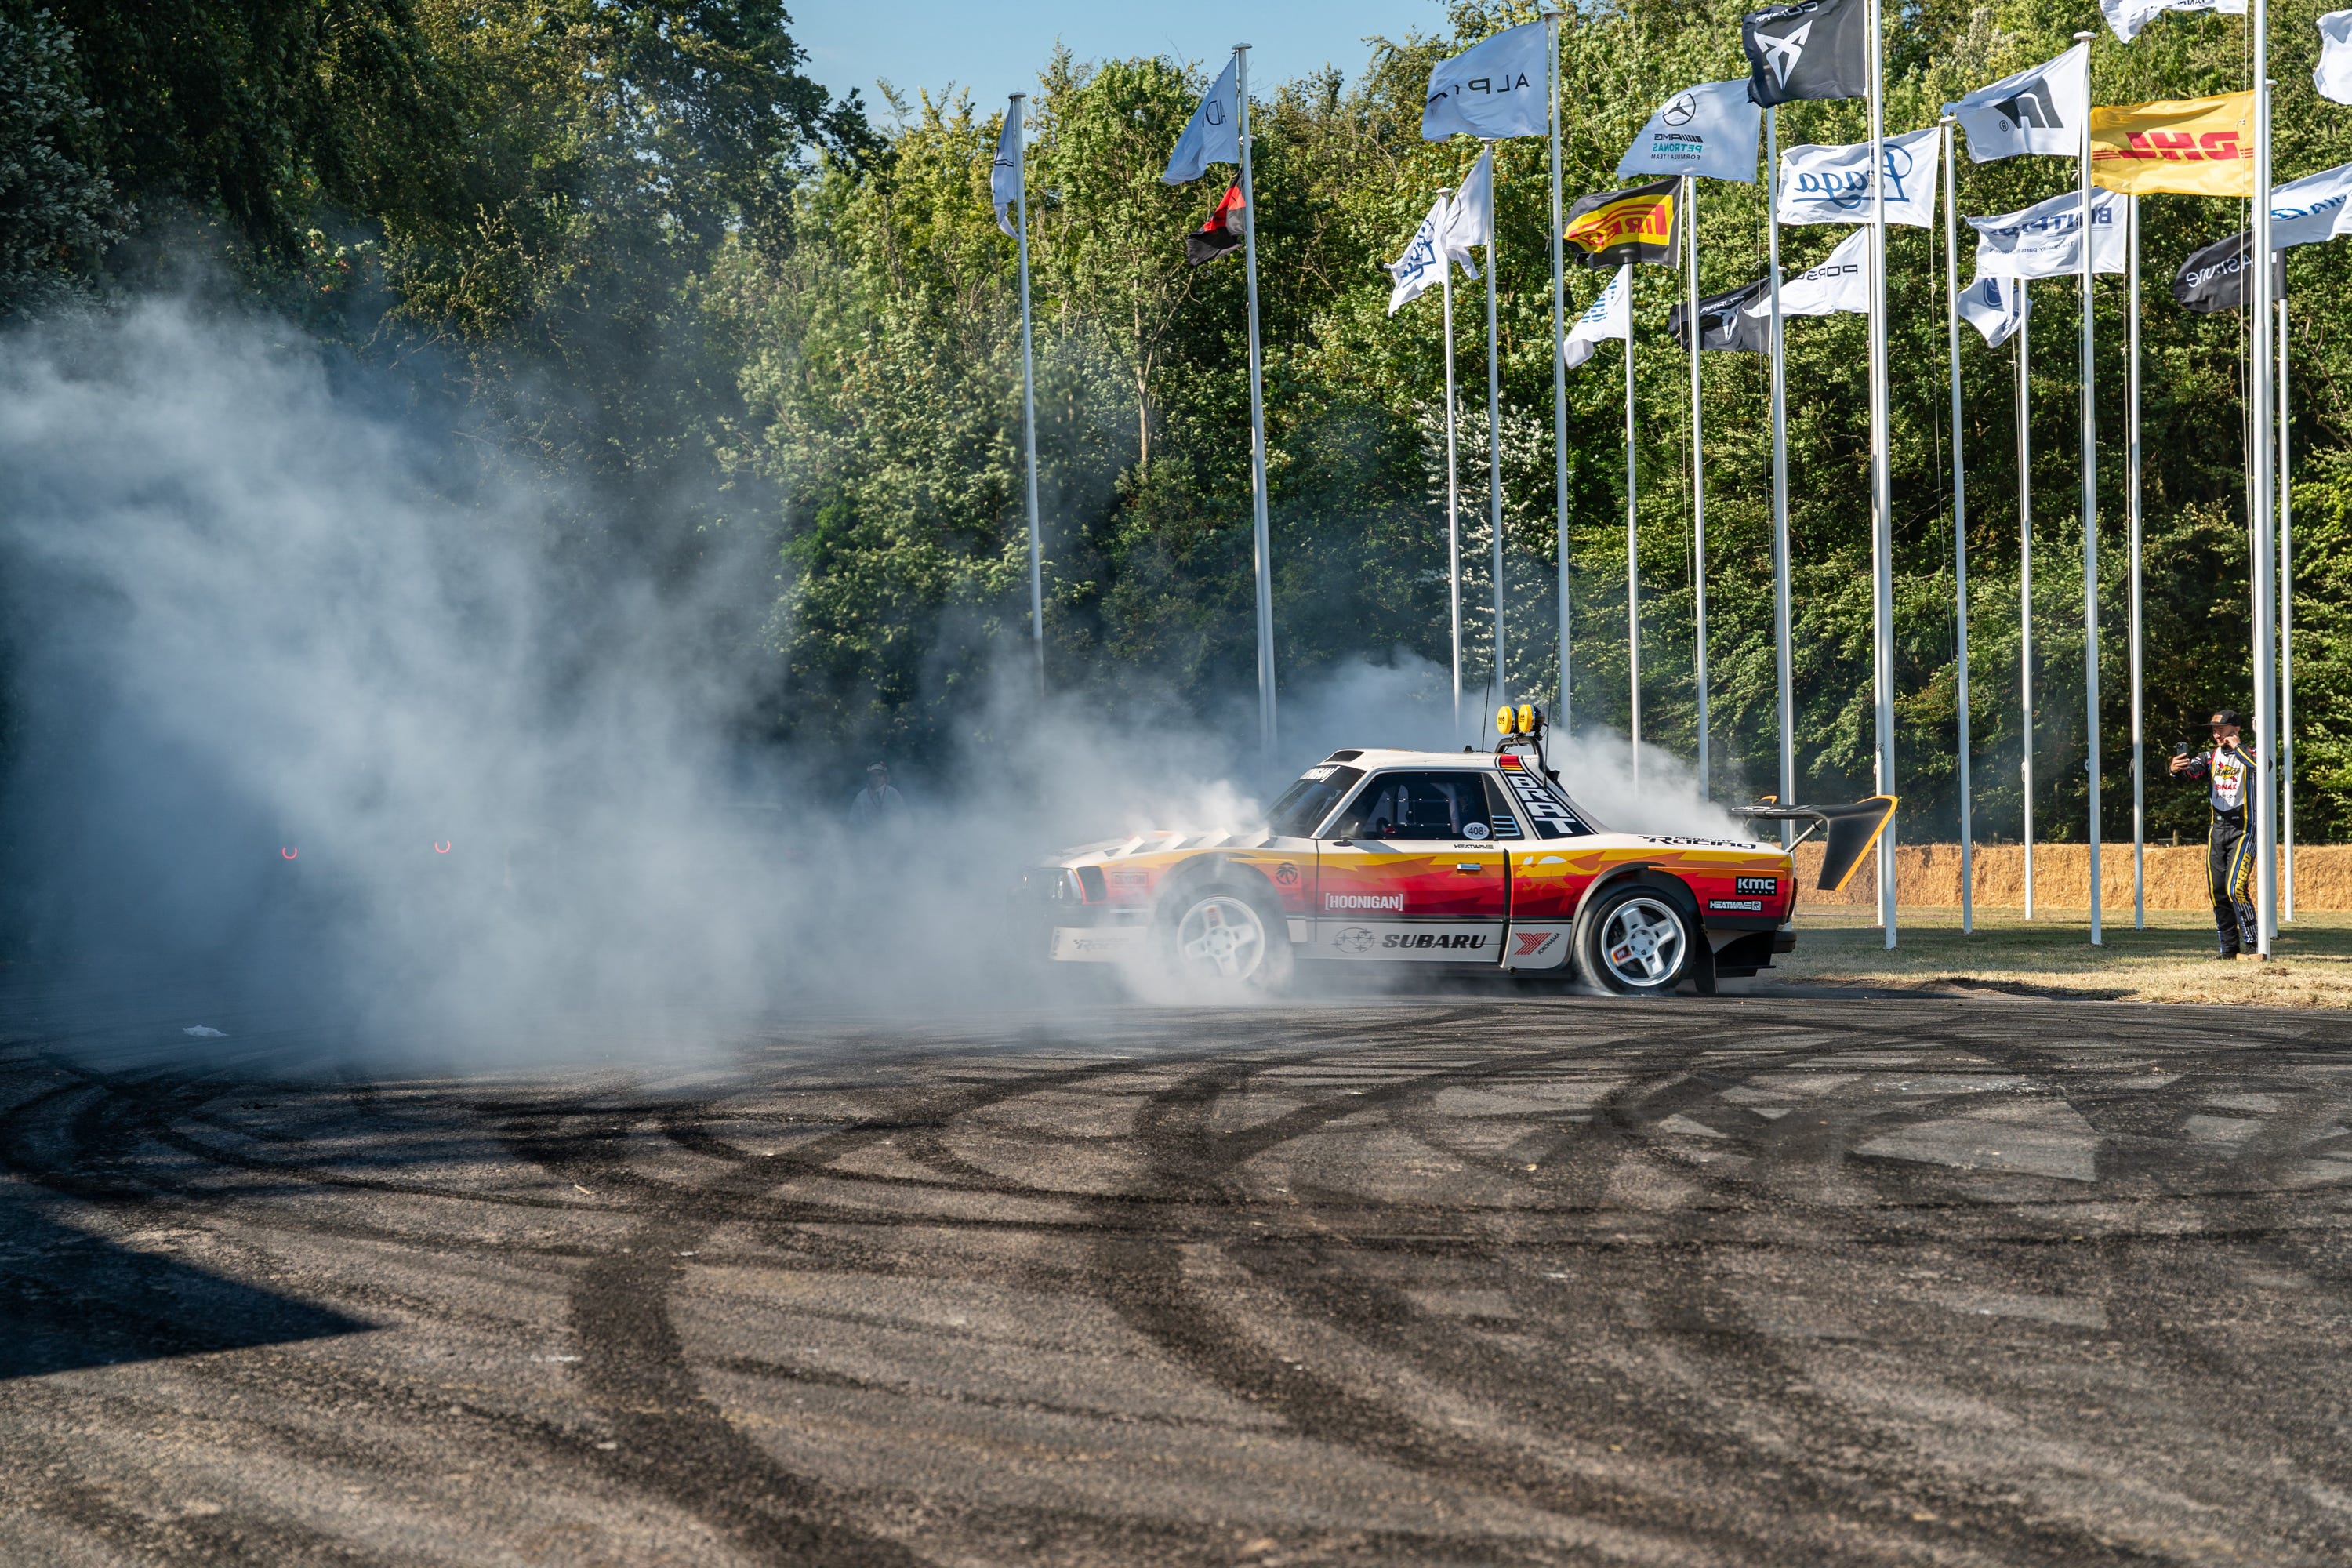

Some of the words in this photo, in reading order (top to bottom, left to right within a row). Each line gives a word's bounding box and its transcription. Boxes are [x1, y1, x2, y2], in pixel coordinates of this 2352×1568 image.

[1508, 775, 1577, 834] BRAT
[1468, 826, 1484, 836] 408
[1648, 836, 1757, 850] Racing
[1325, 892, 1403, 912] [HOONIGAN]
[1709, 900, 1752, 909] HEATWAVE
[1382, 934, 1487, 949] SUBARU
[1537, 932, 1562, 955] YOKOHAMA
